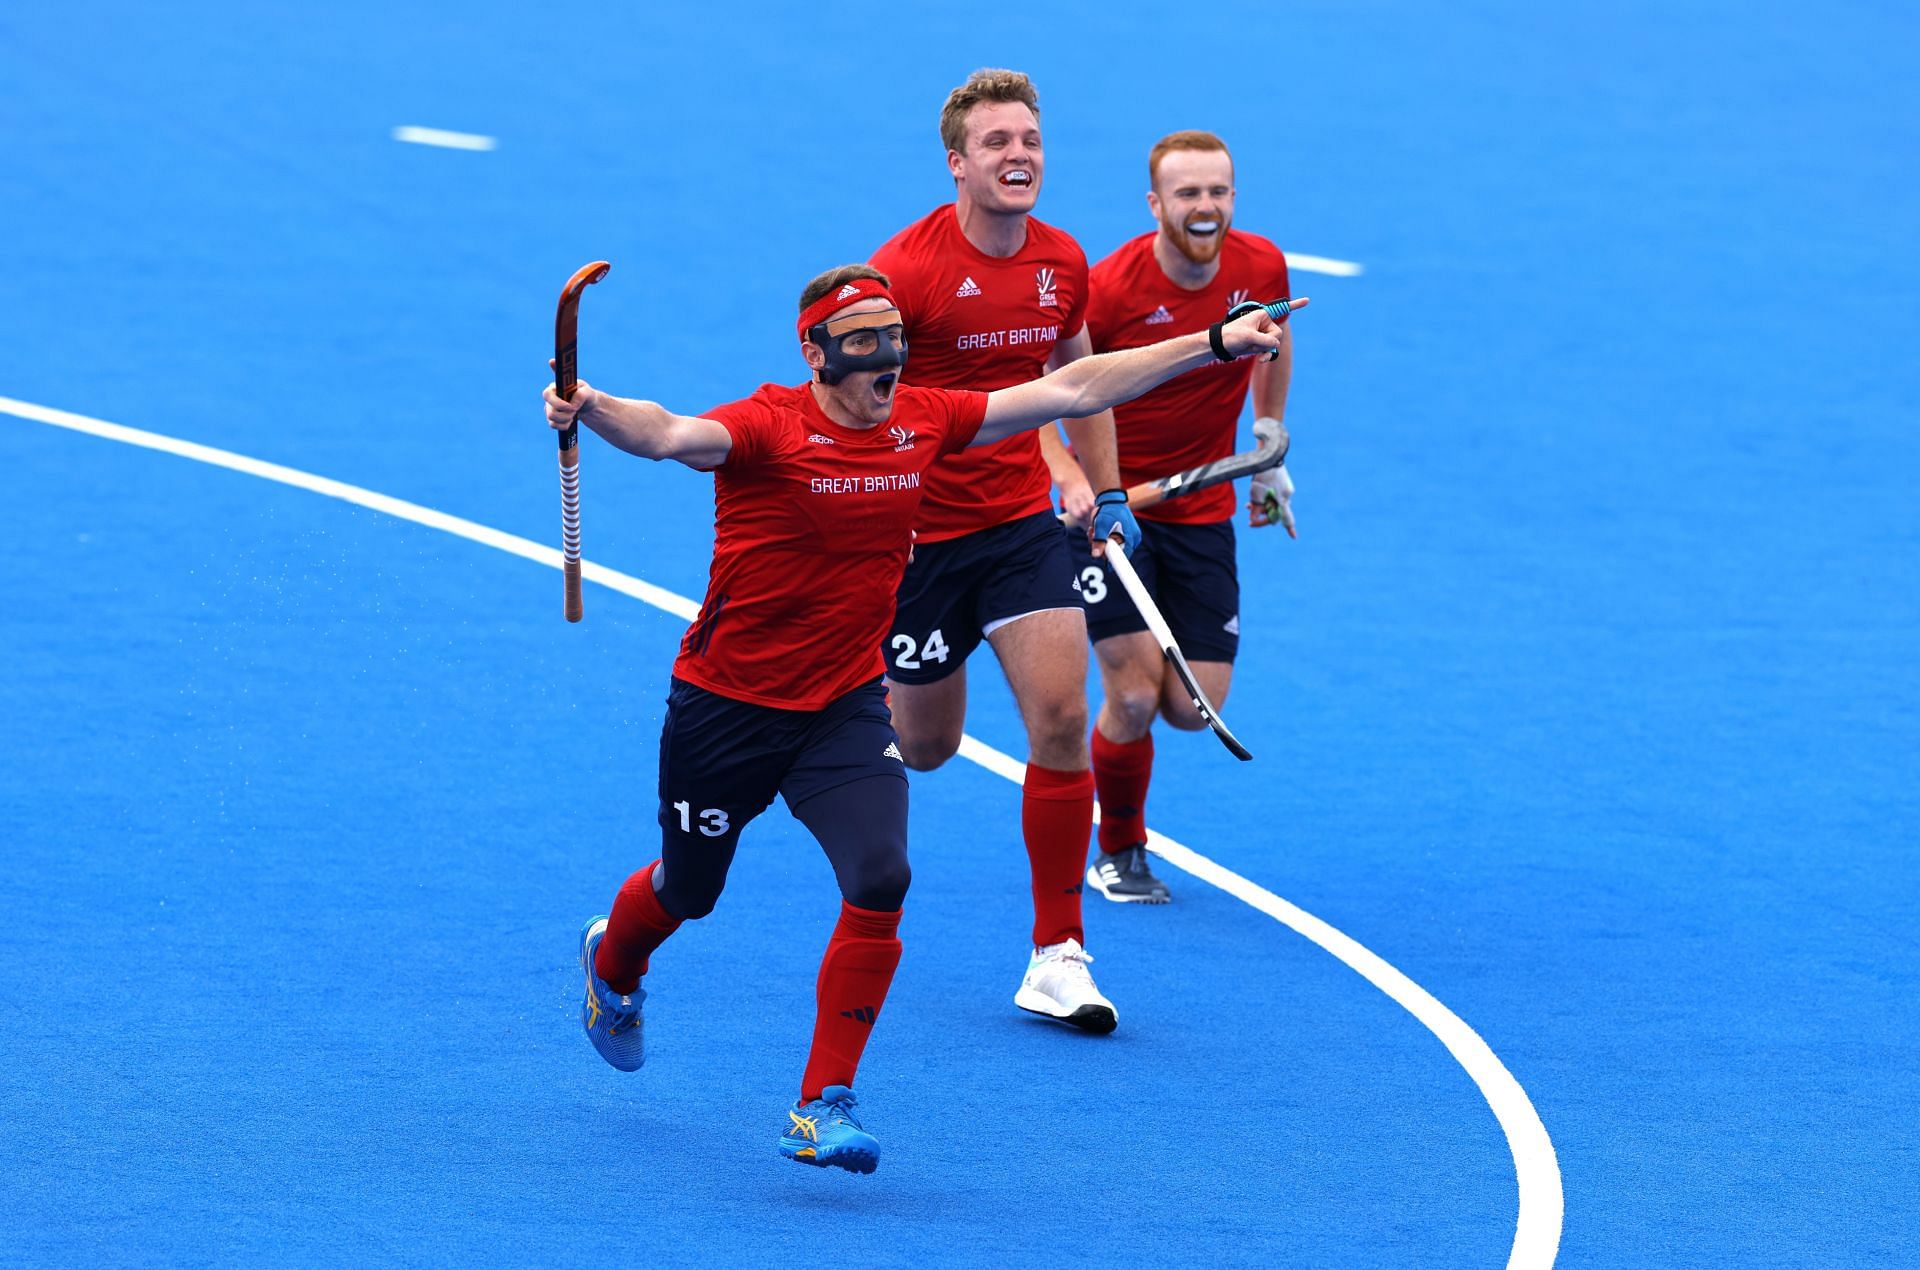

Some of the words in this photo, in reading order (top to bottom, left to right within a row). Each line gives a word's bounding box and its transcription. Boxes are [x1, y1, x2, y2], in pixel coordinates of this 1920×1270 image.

[956, 288, 982, 298] adidas
[1039, 293, 1057, 301] GREAT
[957, 331, 1006, 350] GREAT
[1009, 325, 1058, 345] BRITAIN
[808, 434, 834, 445] adidas
[894, 443, 915, 453] BRITAIN
[811, 477, 861, 494] GREAT
[864, 472, 920, 492] BRITAIN
[1081, 566, 1108, 604] 3
[891, 628, 950, 670] 24
[673, 800, 730, 837] 13
